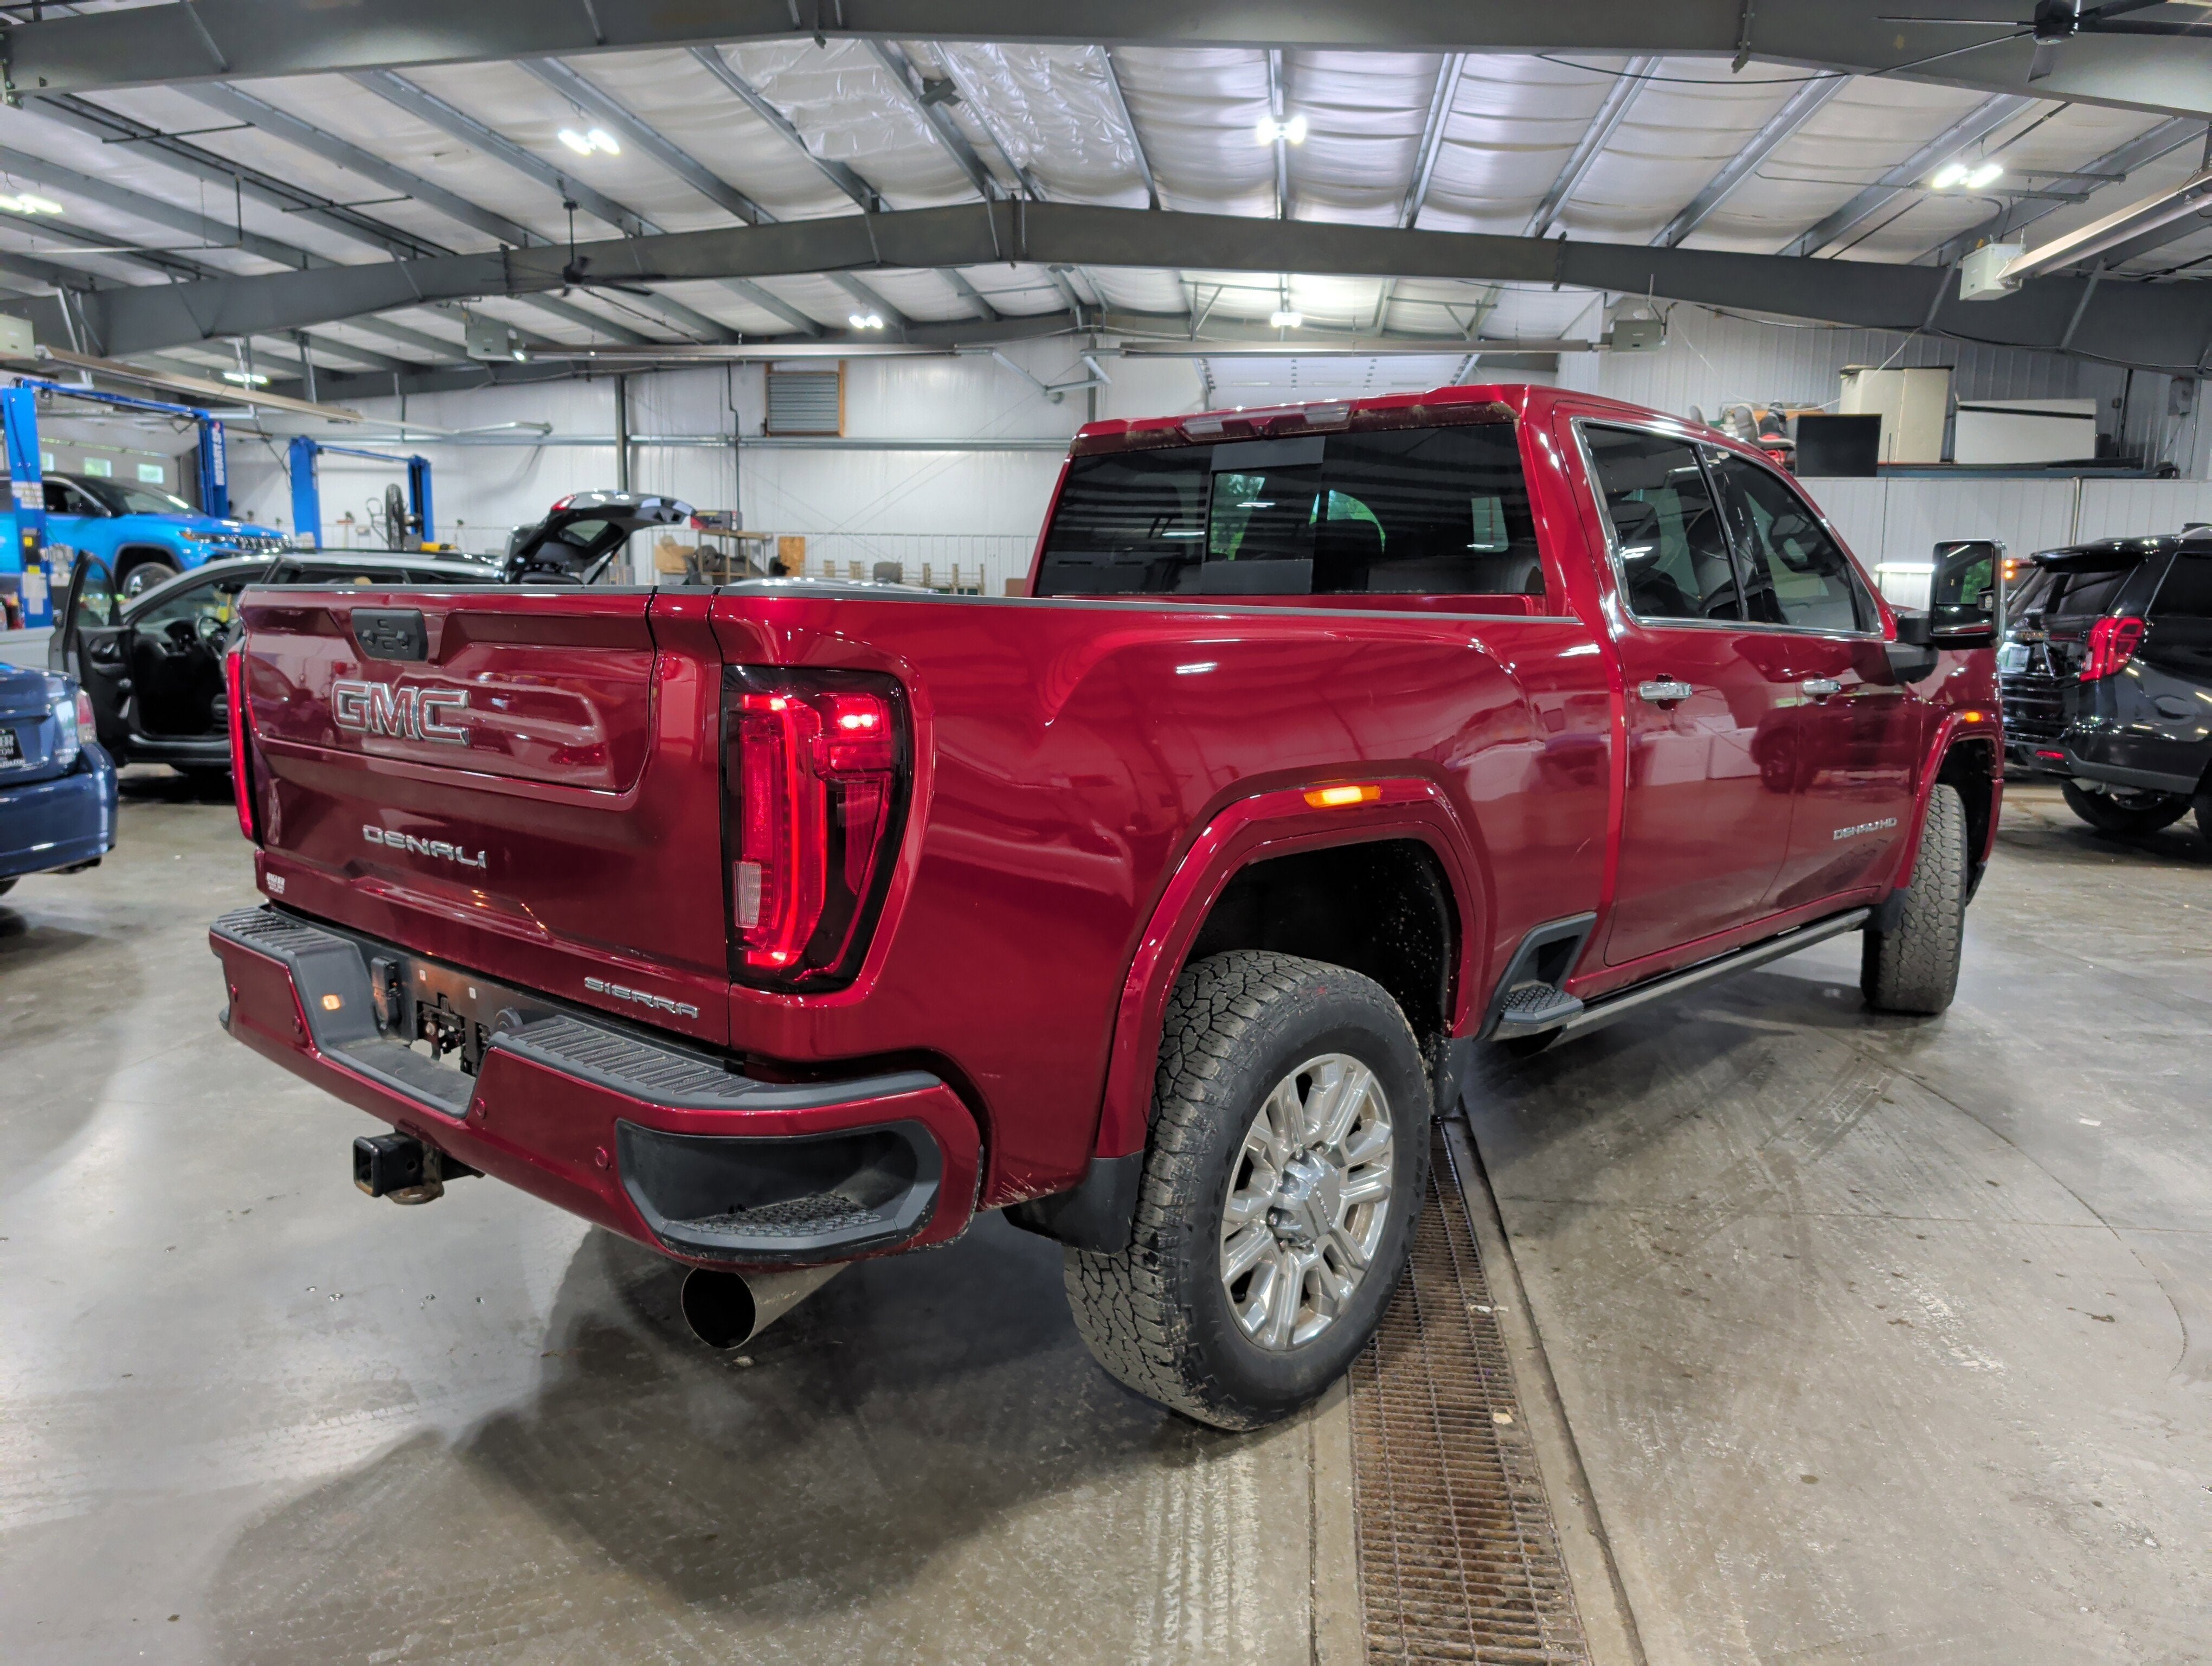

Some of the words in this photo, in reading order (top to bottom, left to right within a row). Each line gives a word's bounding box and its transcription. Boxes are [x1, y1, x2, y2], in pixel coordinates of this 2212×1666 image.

[332, 680, 470, 747] GMC
[363, 824, 487, 869] DENALI
[1833, 821, 1879, 840] DENALI
[584, 976, 699, 1018] SIERRA
